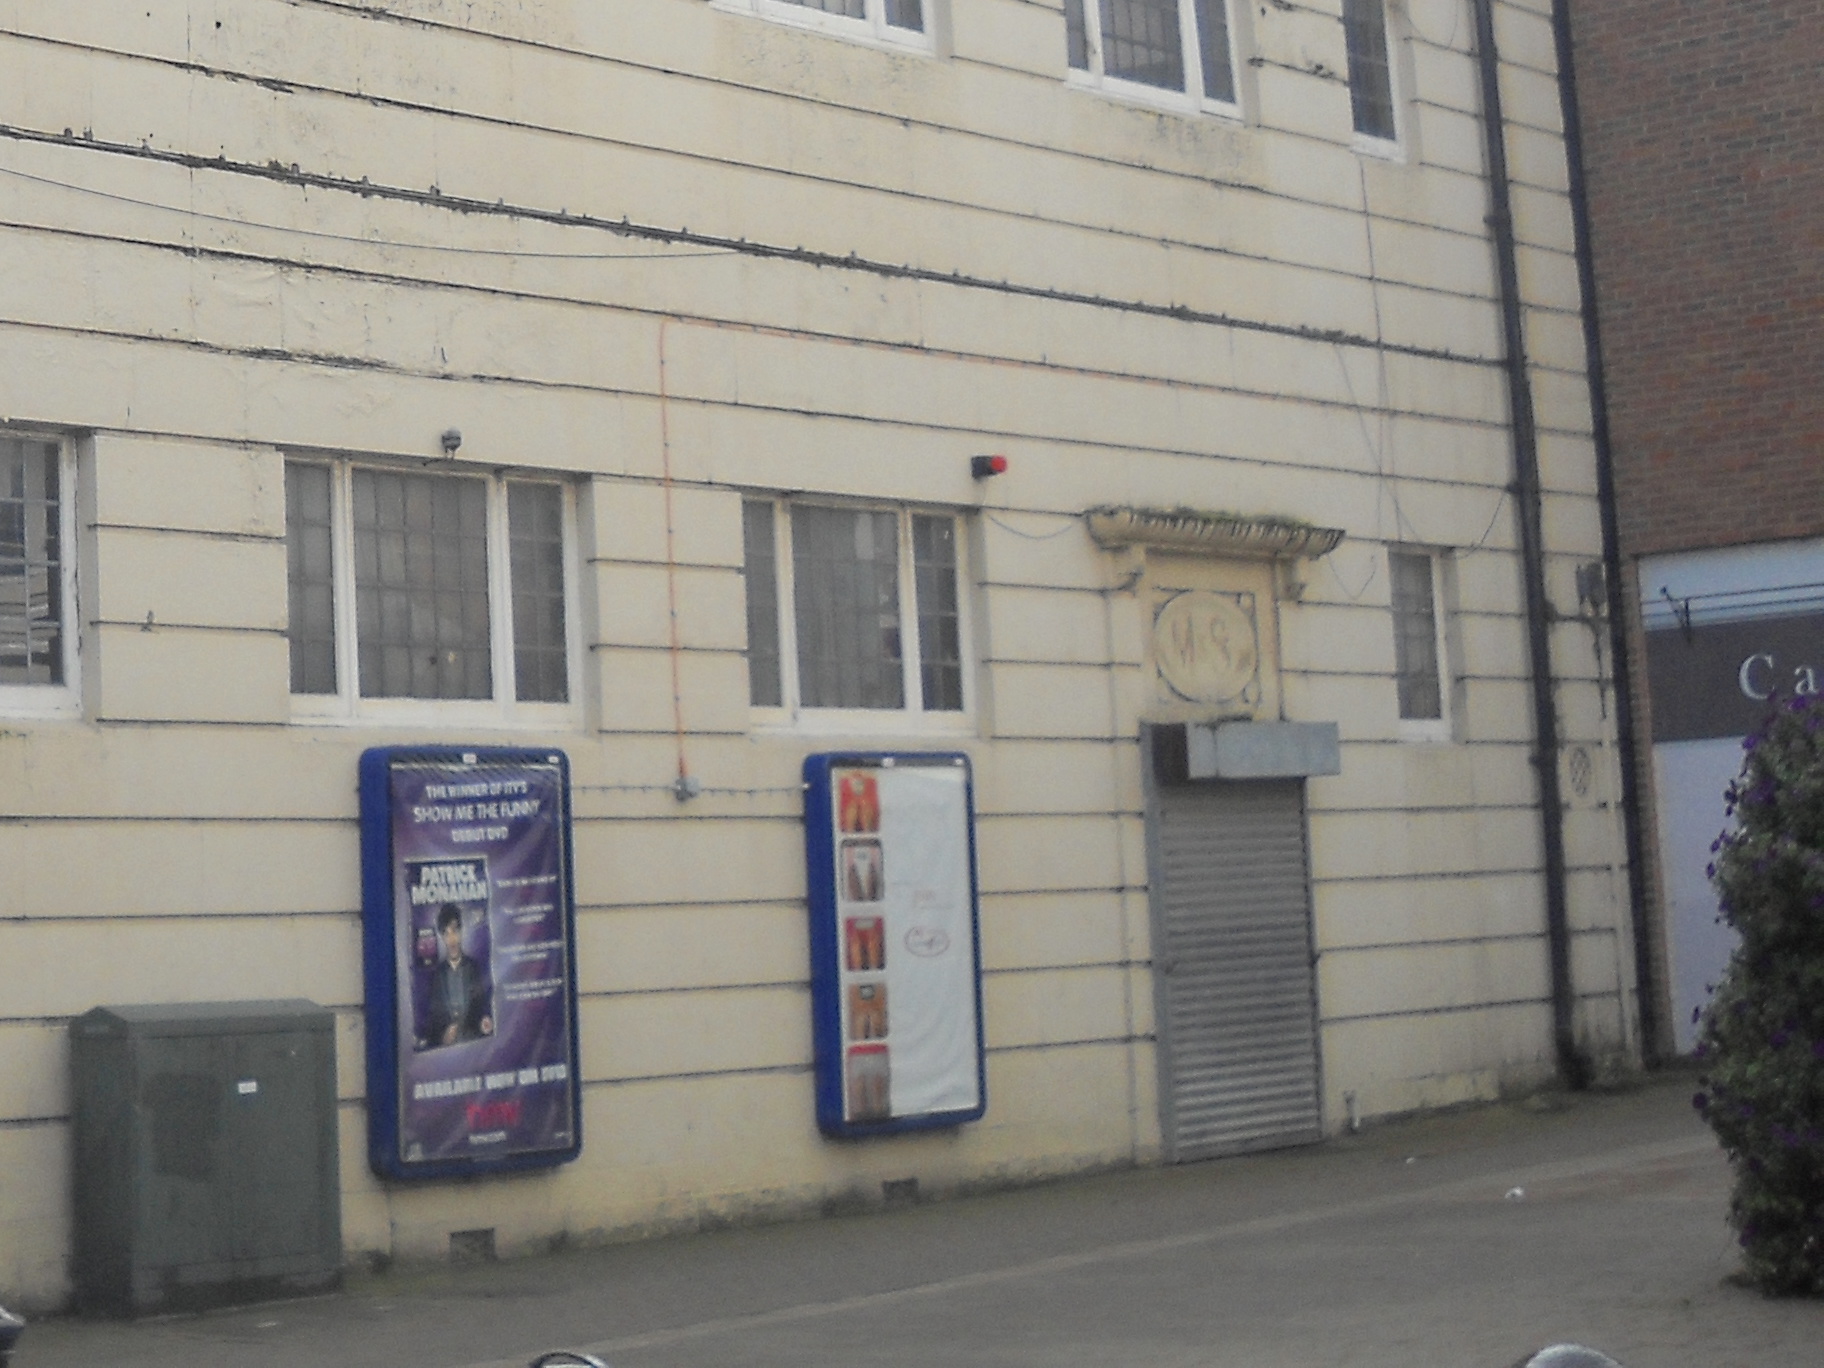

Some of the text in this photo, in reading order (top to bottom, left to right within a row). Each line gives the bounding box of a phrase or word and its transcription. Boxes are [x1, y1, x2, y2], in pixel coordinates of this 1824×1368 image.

[414, 800, 540, 823] SHOW ME THE FUNNY
[422, 865, 476, 885] PATRICK
[412, 880, 487, 904] MONAHAN
